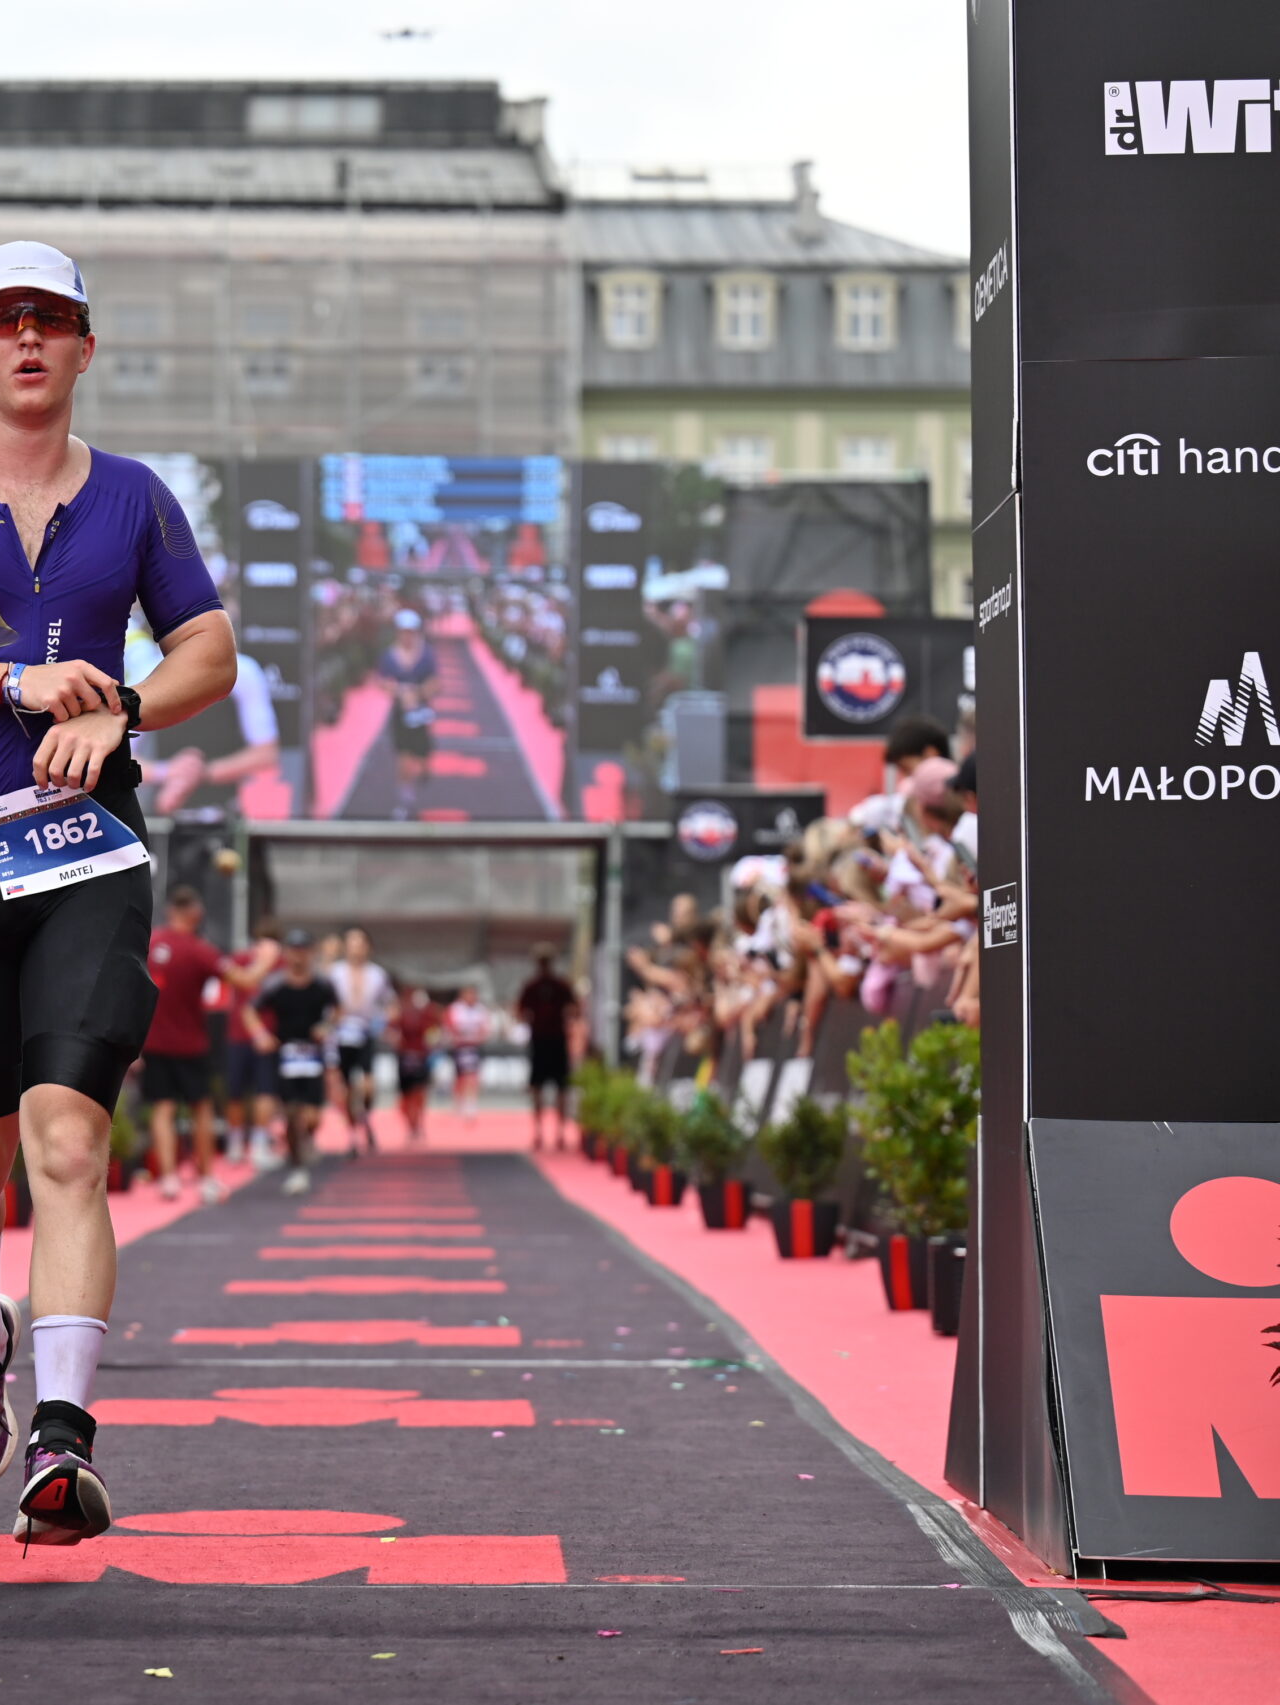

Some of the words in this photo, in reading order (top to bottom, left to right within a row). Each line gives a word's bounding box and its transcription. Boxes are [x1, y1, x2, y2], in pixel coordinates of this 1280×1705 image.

[1135, 79, 1280, 155] Wi
[974, 238, 1008, 322] QEMETICA
[1087, 433, 1161, 477] citi
[979, 573, 1012, 634] sportano.pl
[24, 812, 103, 855] 1862
[59, 864, 94, 881] MATEJ
